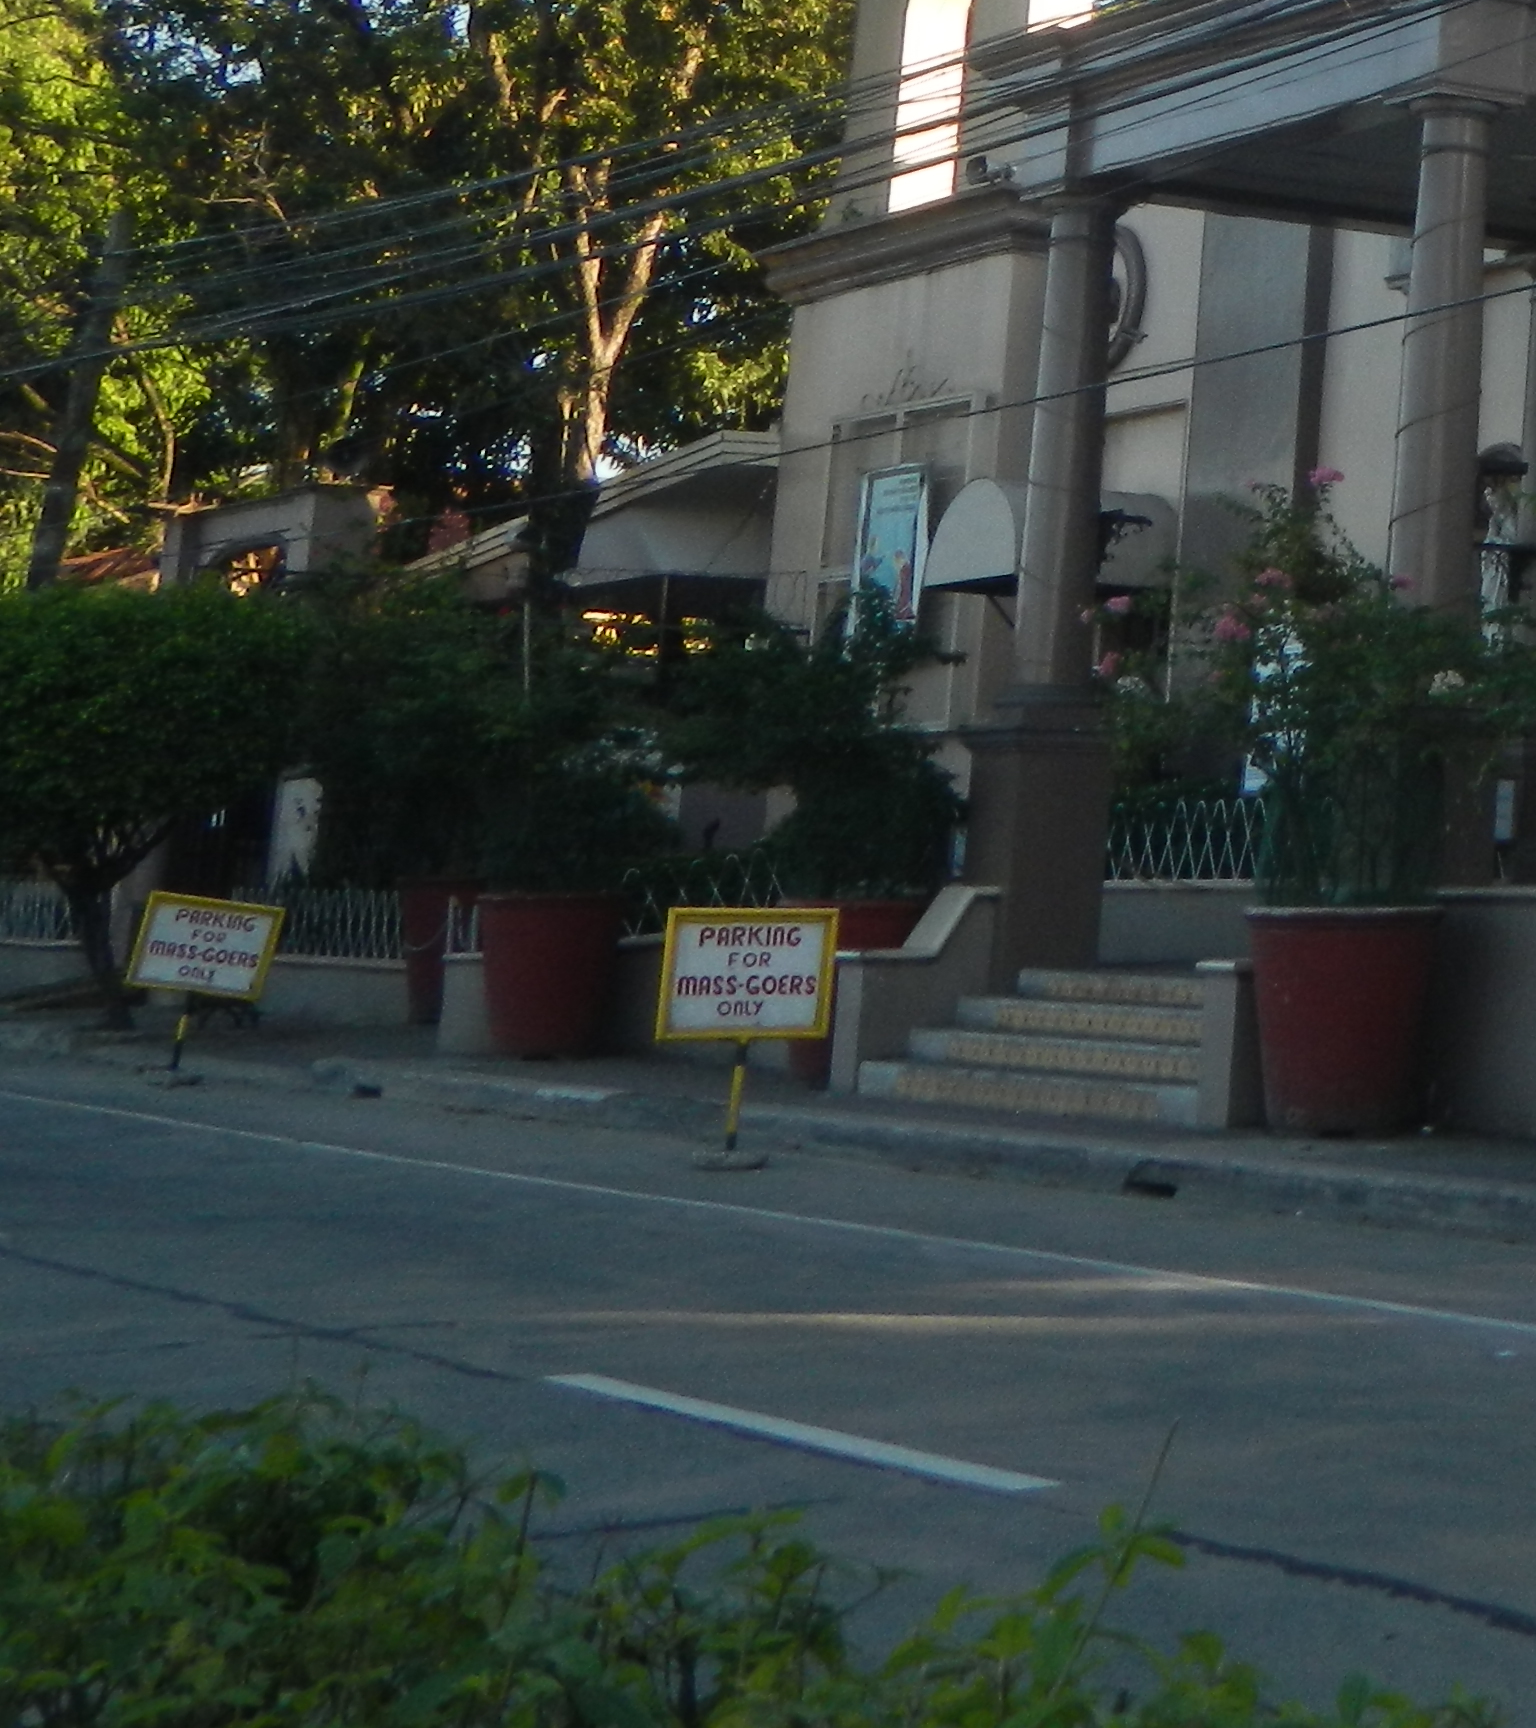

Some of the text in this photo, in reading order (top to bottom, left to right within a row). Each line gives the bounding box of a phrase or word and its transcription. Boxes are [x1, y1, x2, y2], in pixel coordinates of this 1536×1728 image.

[175, 908, 258, 933] PARKING
[191, 929, 227, 943] FOR
[699, 926, 802, 947] PARKING
[149, 939, 260, 969] MASS-GOERS
[727, 951, 772, 968] FOR
[178, 965, 216, 982] ONLY
[676, 974, 817, 996] MASS-GOERS
[716, 1000, 763, 1016] ONLY
